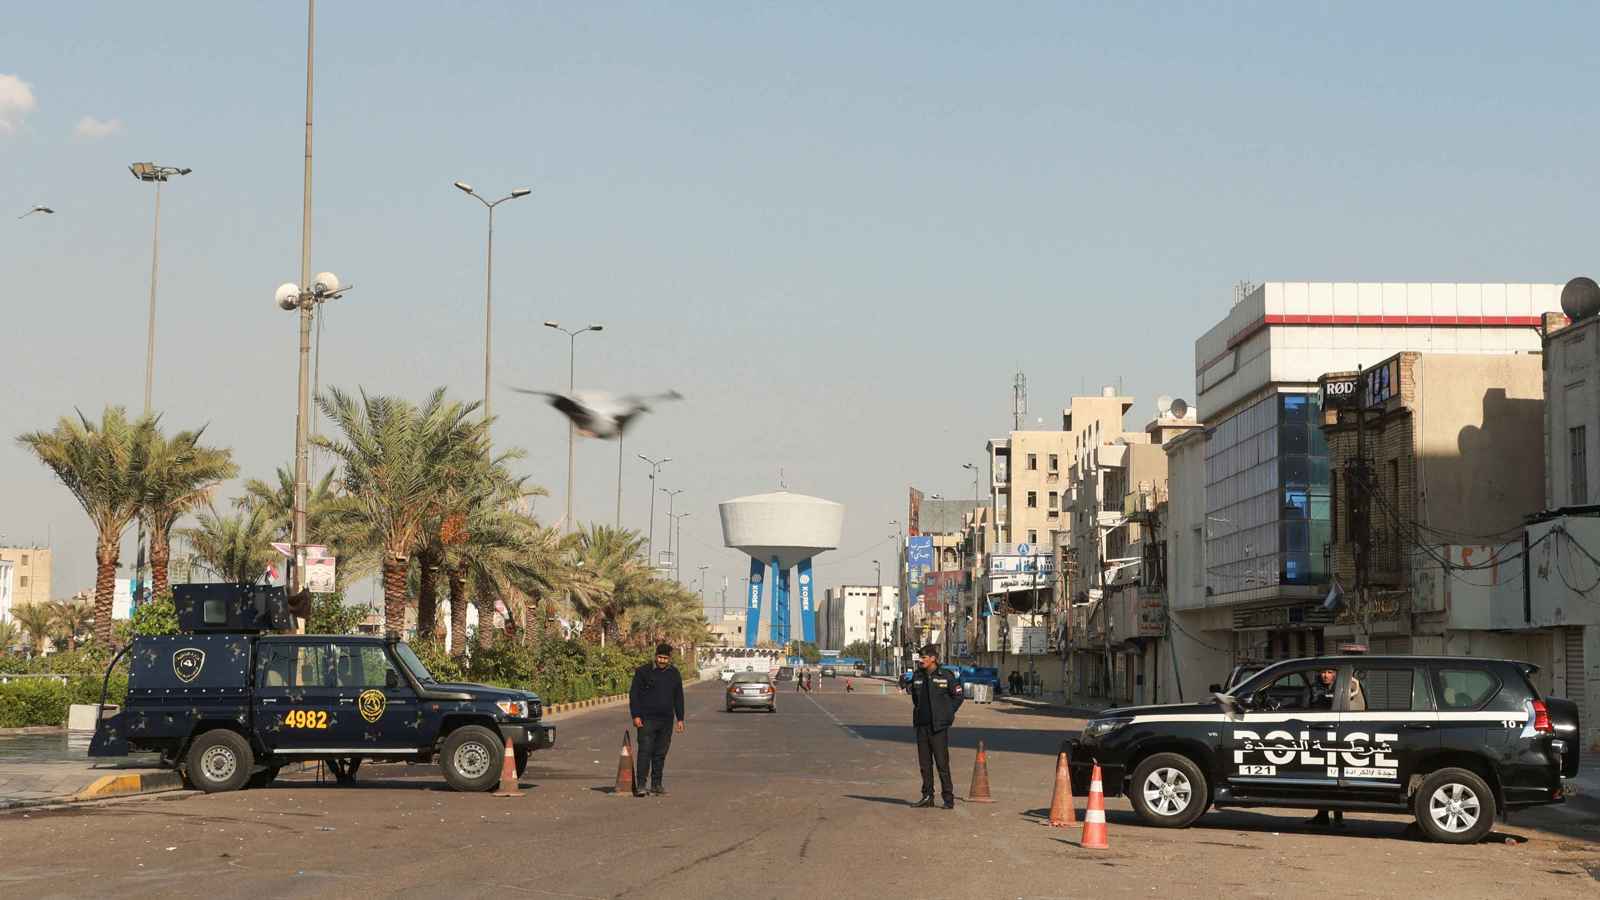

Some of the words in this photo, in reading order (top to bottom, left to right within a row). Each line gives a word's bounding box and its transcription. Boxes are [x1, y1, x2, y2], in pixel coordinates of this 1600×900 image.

[285, 710, 327, 728] 4982
[1233, 730, 1399, 767] POLICE
[1243, 766, 1272, 774] 121
